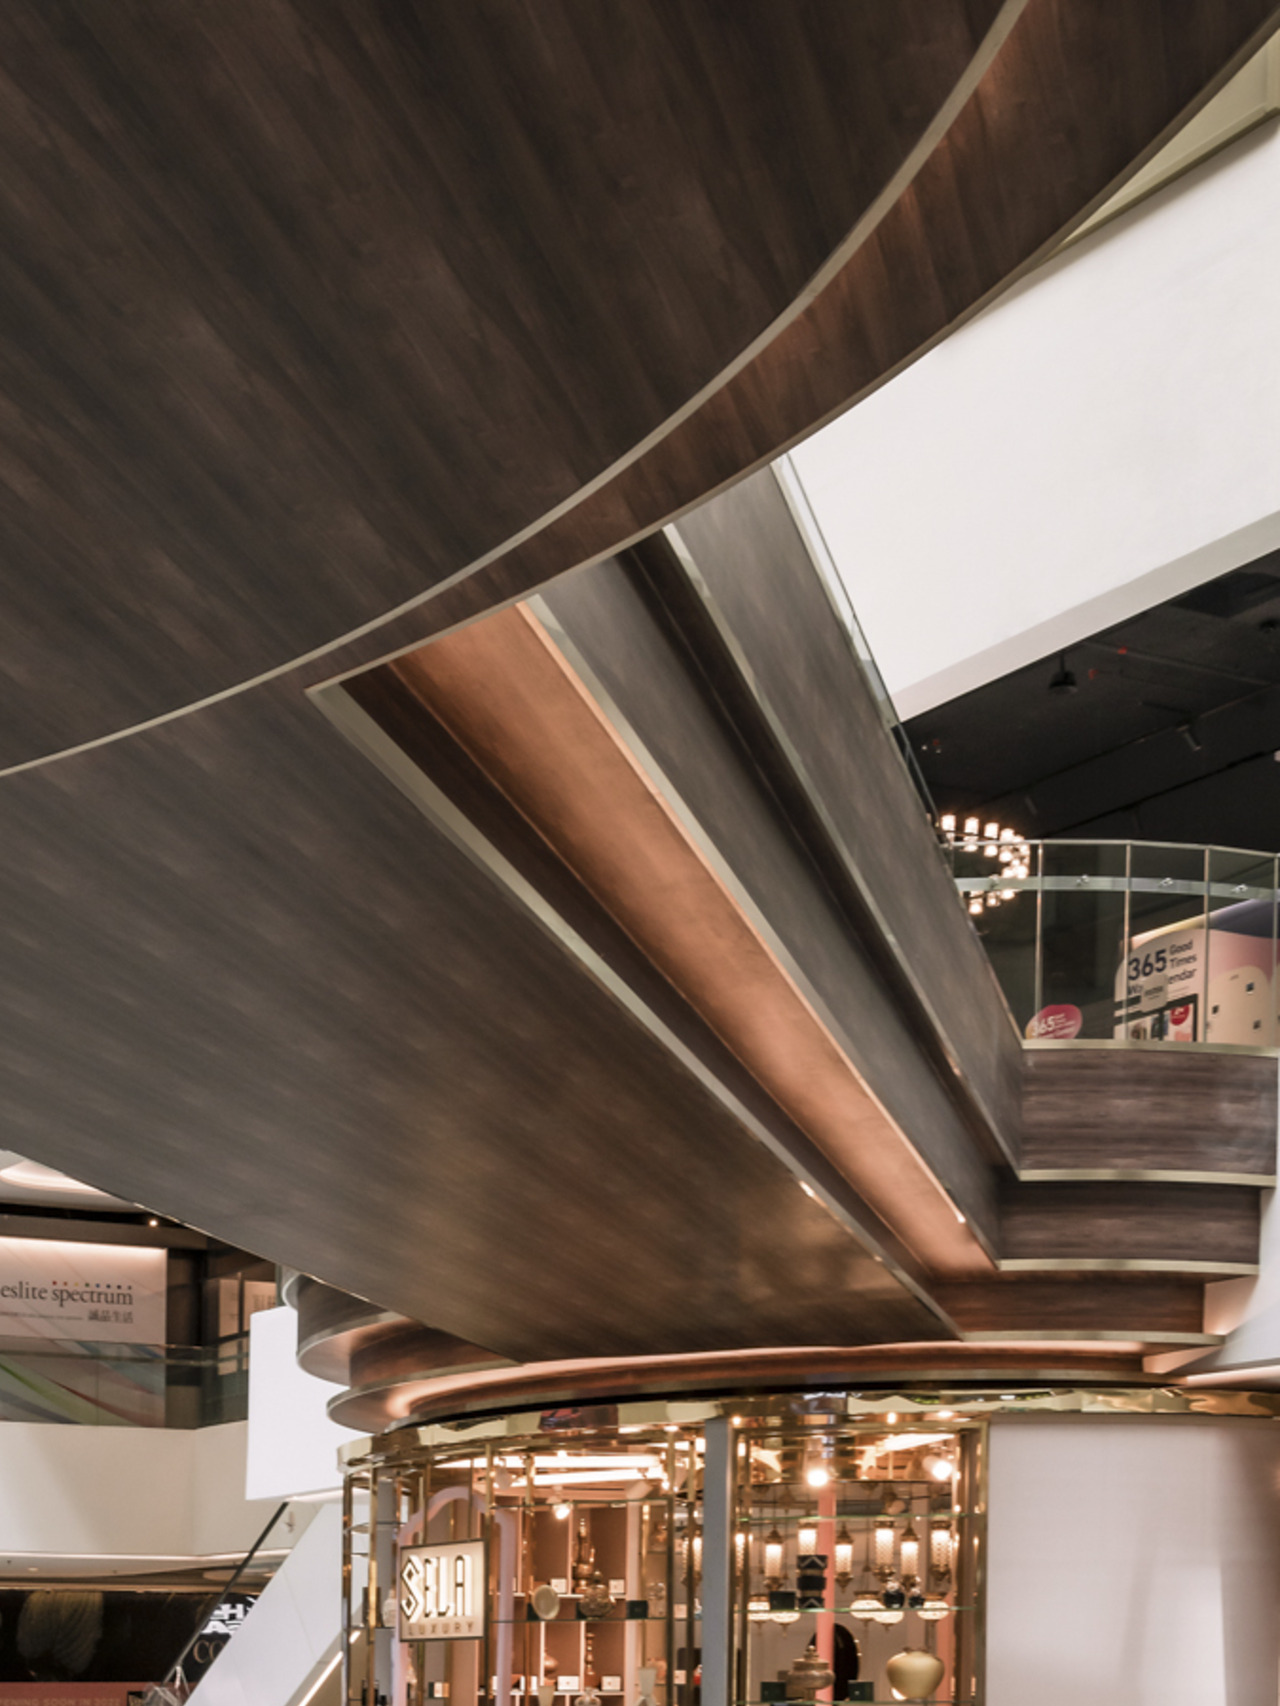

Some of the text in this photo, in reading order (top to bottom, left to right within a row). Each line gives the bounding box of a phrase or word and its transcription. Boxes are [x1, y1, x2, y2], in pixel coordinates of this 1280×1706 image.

[1169, 939, 1193, 955] Good
[1128, 949, 1166, 981] 365
[0, 1280, 133, 1308] eslite spectrum
[408, 1621, 474, 1636] LUXURY
[43, 1697, 76, 1706] SOON
